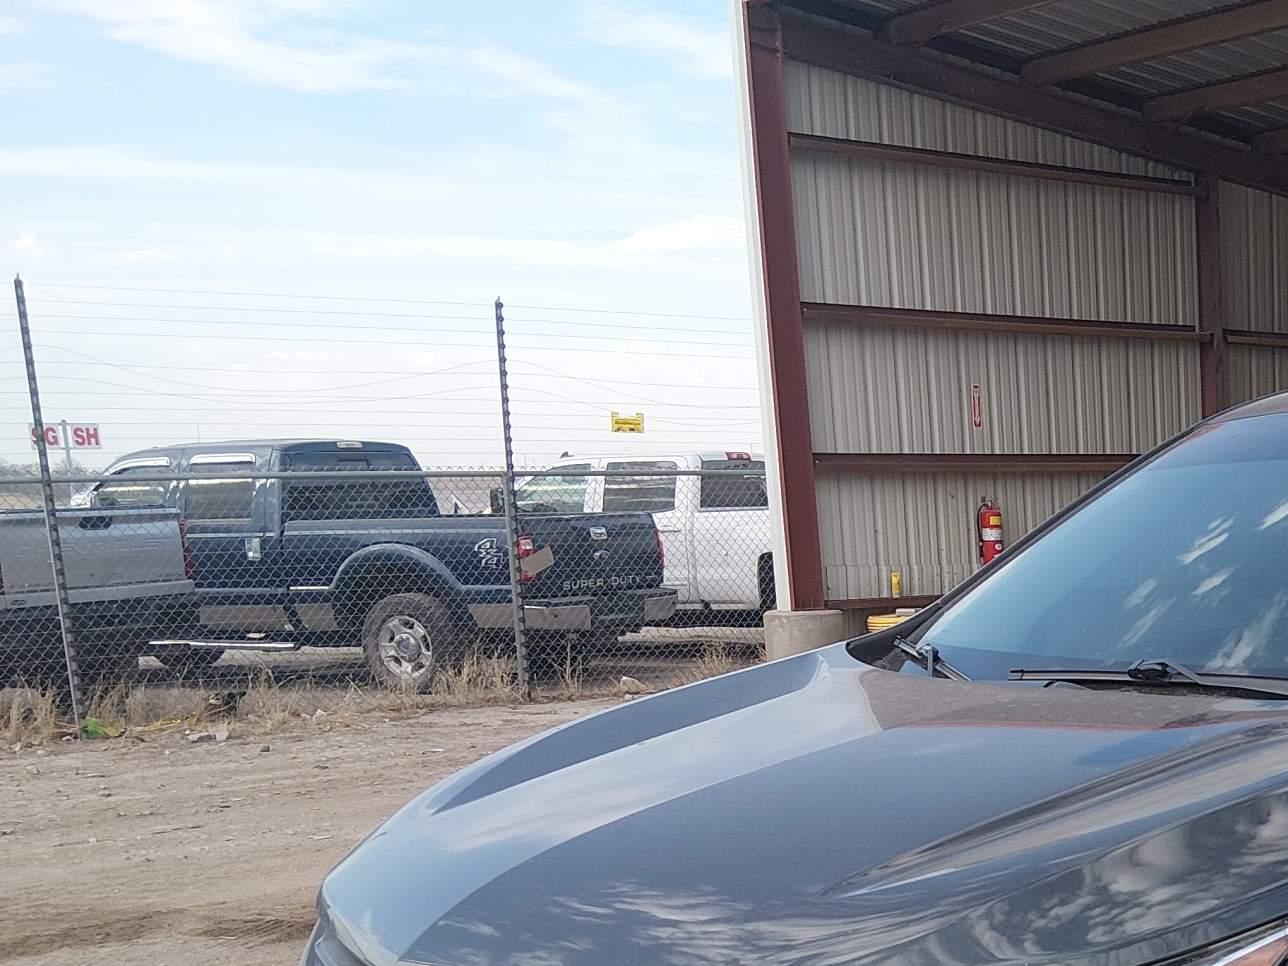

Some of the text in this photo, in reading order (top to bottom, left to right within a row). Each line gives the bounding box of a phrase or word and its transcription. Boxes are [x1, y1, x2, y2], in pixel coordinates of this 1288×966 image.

[73, 427, 99, 446] SH
[562, 577, 604, 591] SUPER
[611, 575, 642, 586] DUTY
